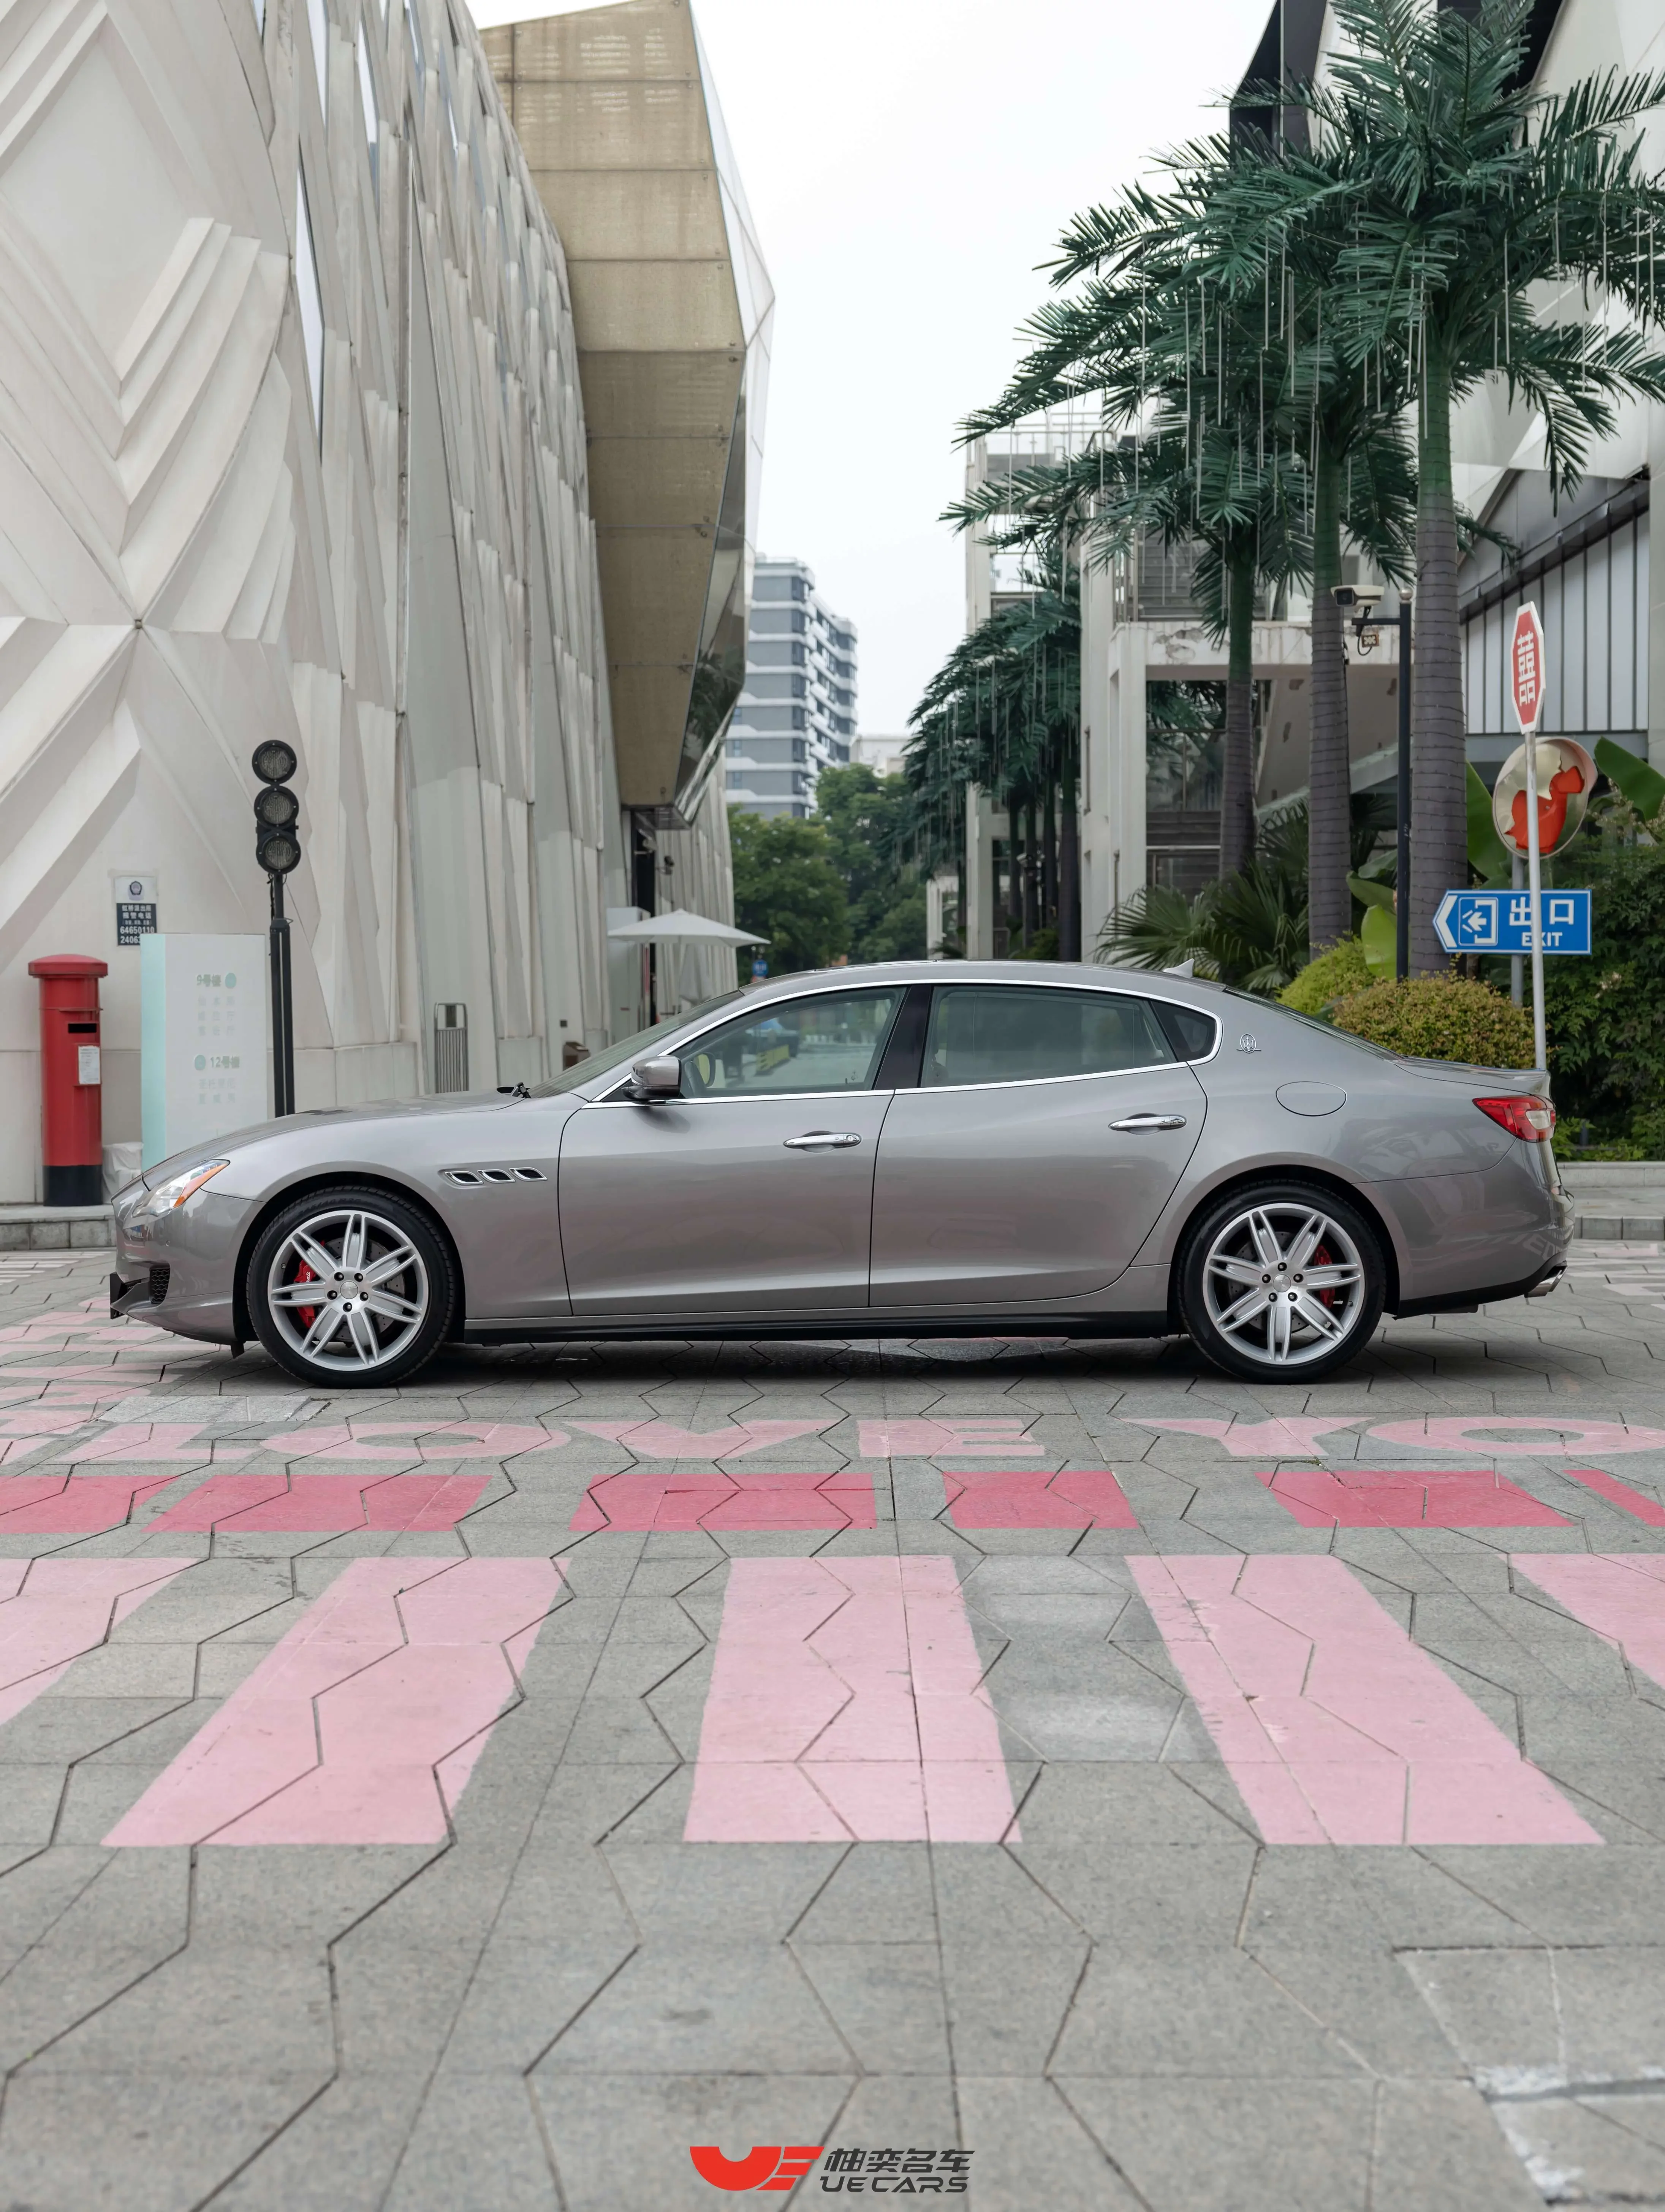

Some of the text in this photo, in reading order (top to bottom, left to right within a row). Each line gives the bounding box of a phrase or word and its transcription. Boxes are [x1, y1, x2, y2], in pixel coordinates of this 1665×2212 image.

[1509, 896, 1574, 926] 出口
[120, 926, 155, 934] 64650110
[55, 1419, 1045, 1461] LOVE
